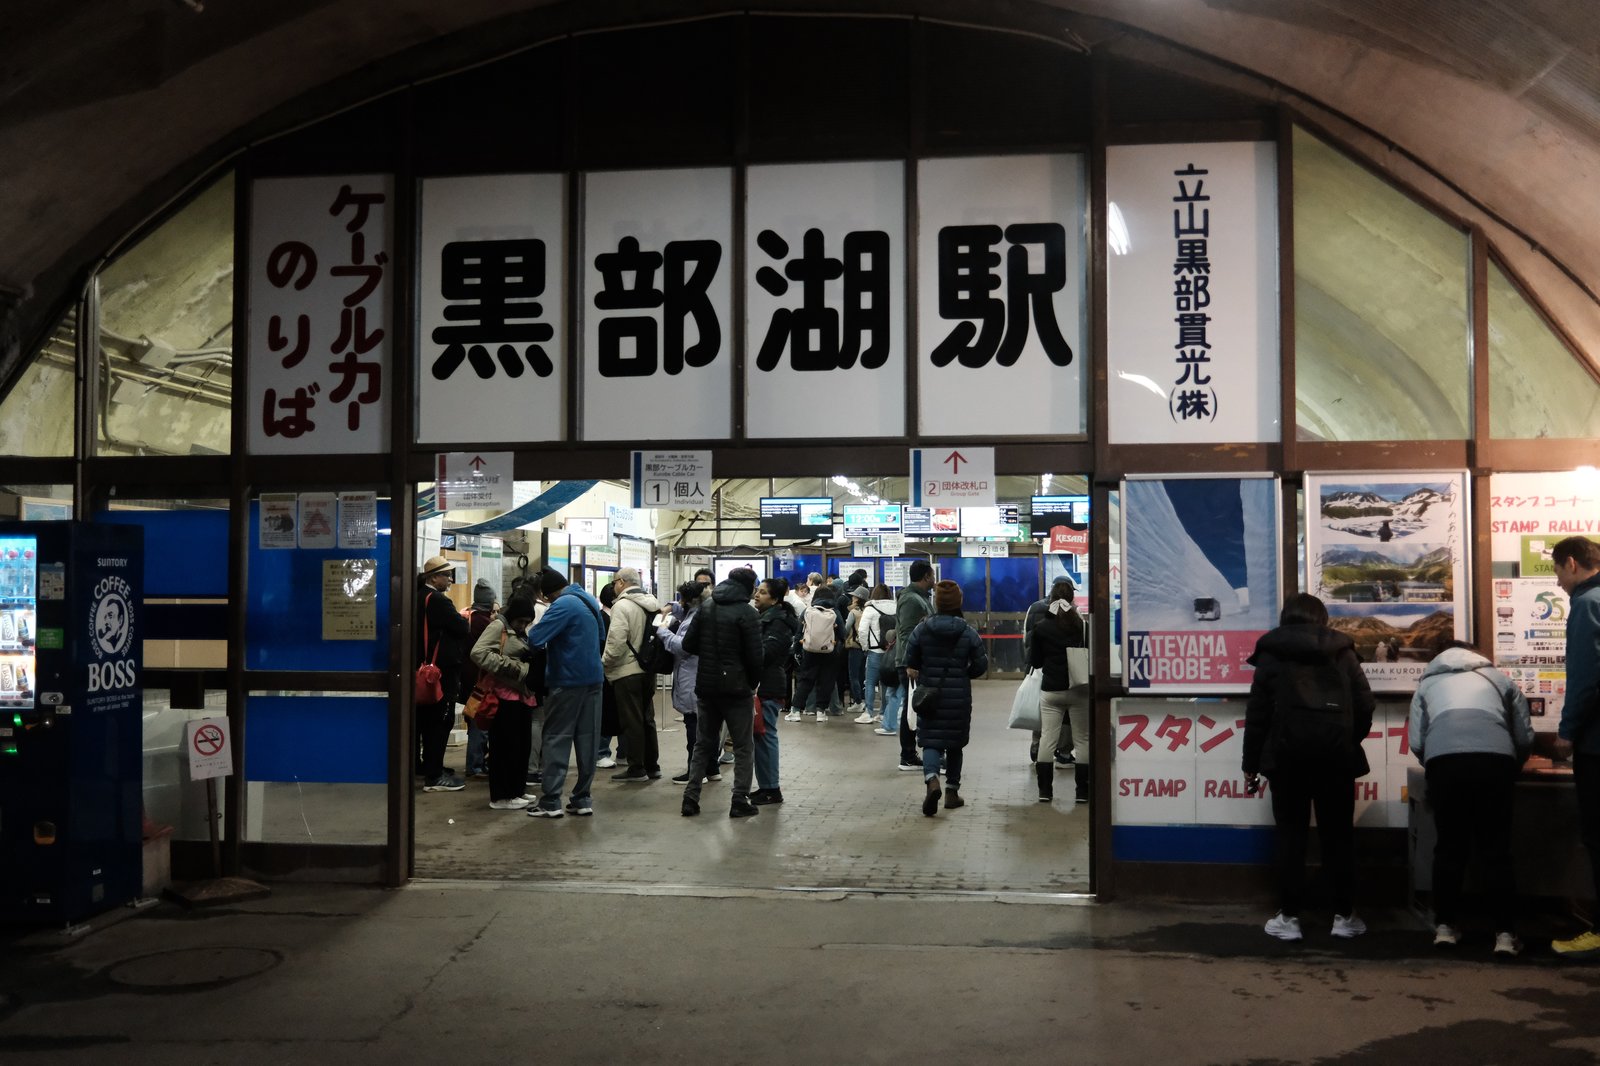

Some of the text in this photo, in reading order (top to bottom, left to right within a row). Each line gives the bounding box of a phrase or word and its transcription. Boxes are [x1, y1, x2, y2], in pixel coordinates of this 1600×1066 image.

[431, 222, 1073, 381] 黒部湖駅
[1169, 163, 1217, 424] 立山黒部貫光(株)
[329, 185, 389, 431] ケーブルカー
[263, 241, 321, 438] のりば
[645, 463, 704, 472] 黒部ケーブルカー
[652, 483, 660, 503] 1
[674, 481, 705, 498] 個人
[928, 482, 936, 495] 2
[942, 481, 988, 491] 団体改札口
[1491, 519, 1540, 533] STAMP
[1548, 519, 1594, 533] RALLY
[981, 546, 988, 555] 2
[97, 557, 129, 567] SUNTORY
[94, 575, 132, 600] COFFEE
[1129, 635, 1228, 657] TATEYAMA
[88, 659, 136, 692] BOSS
[1129, 658, 1211, 681] KUROBE
[1117, 713, 1246, 753] スタン
[1118, 778, 1187, 798] STAMP
